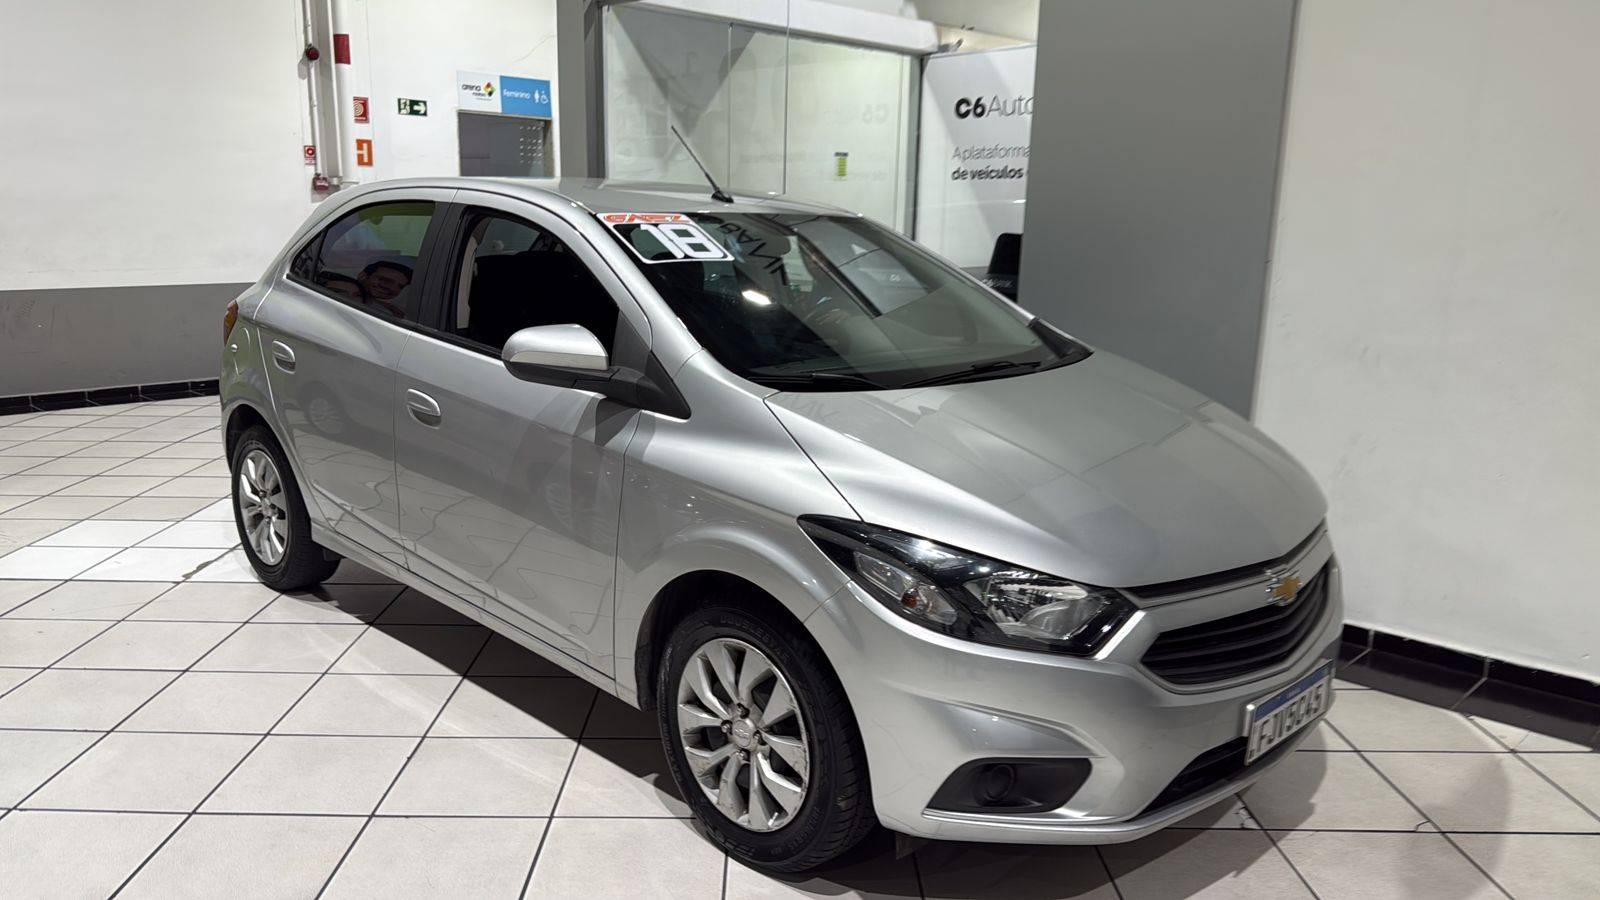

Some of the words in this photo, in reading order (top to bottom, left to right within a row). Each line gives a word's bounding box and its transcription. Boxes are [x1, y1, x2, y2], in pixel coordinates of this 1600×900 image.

[952, 166, 968, 180] de
[971, 165, 1024, 180] veículos
[640, 223, 725, 259] 18
